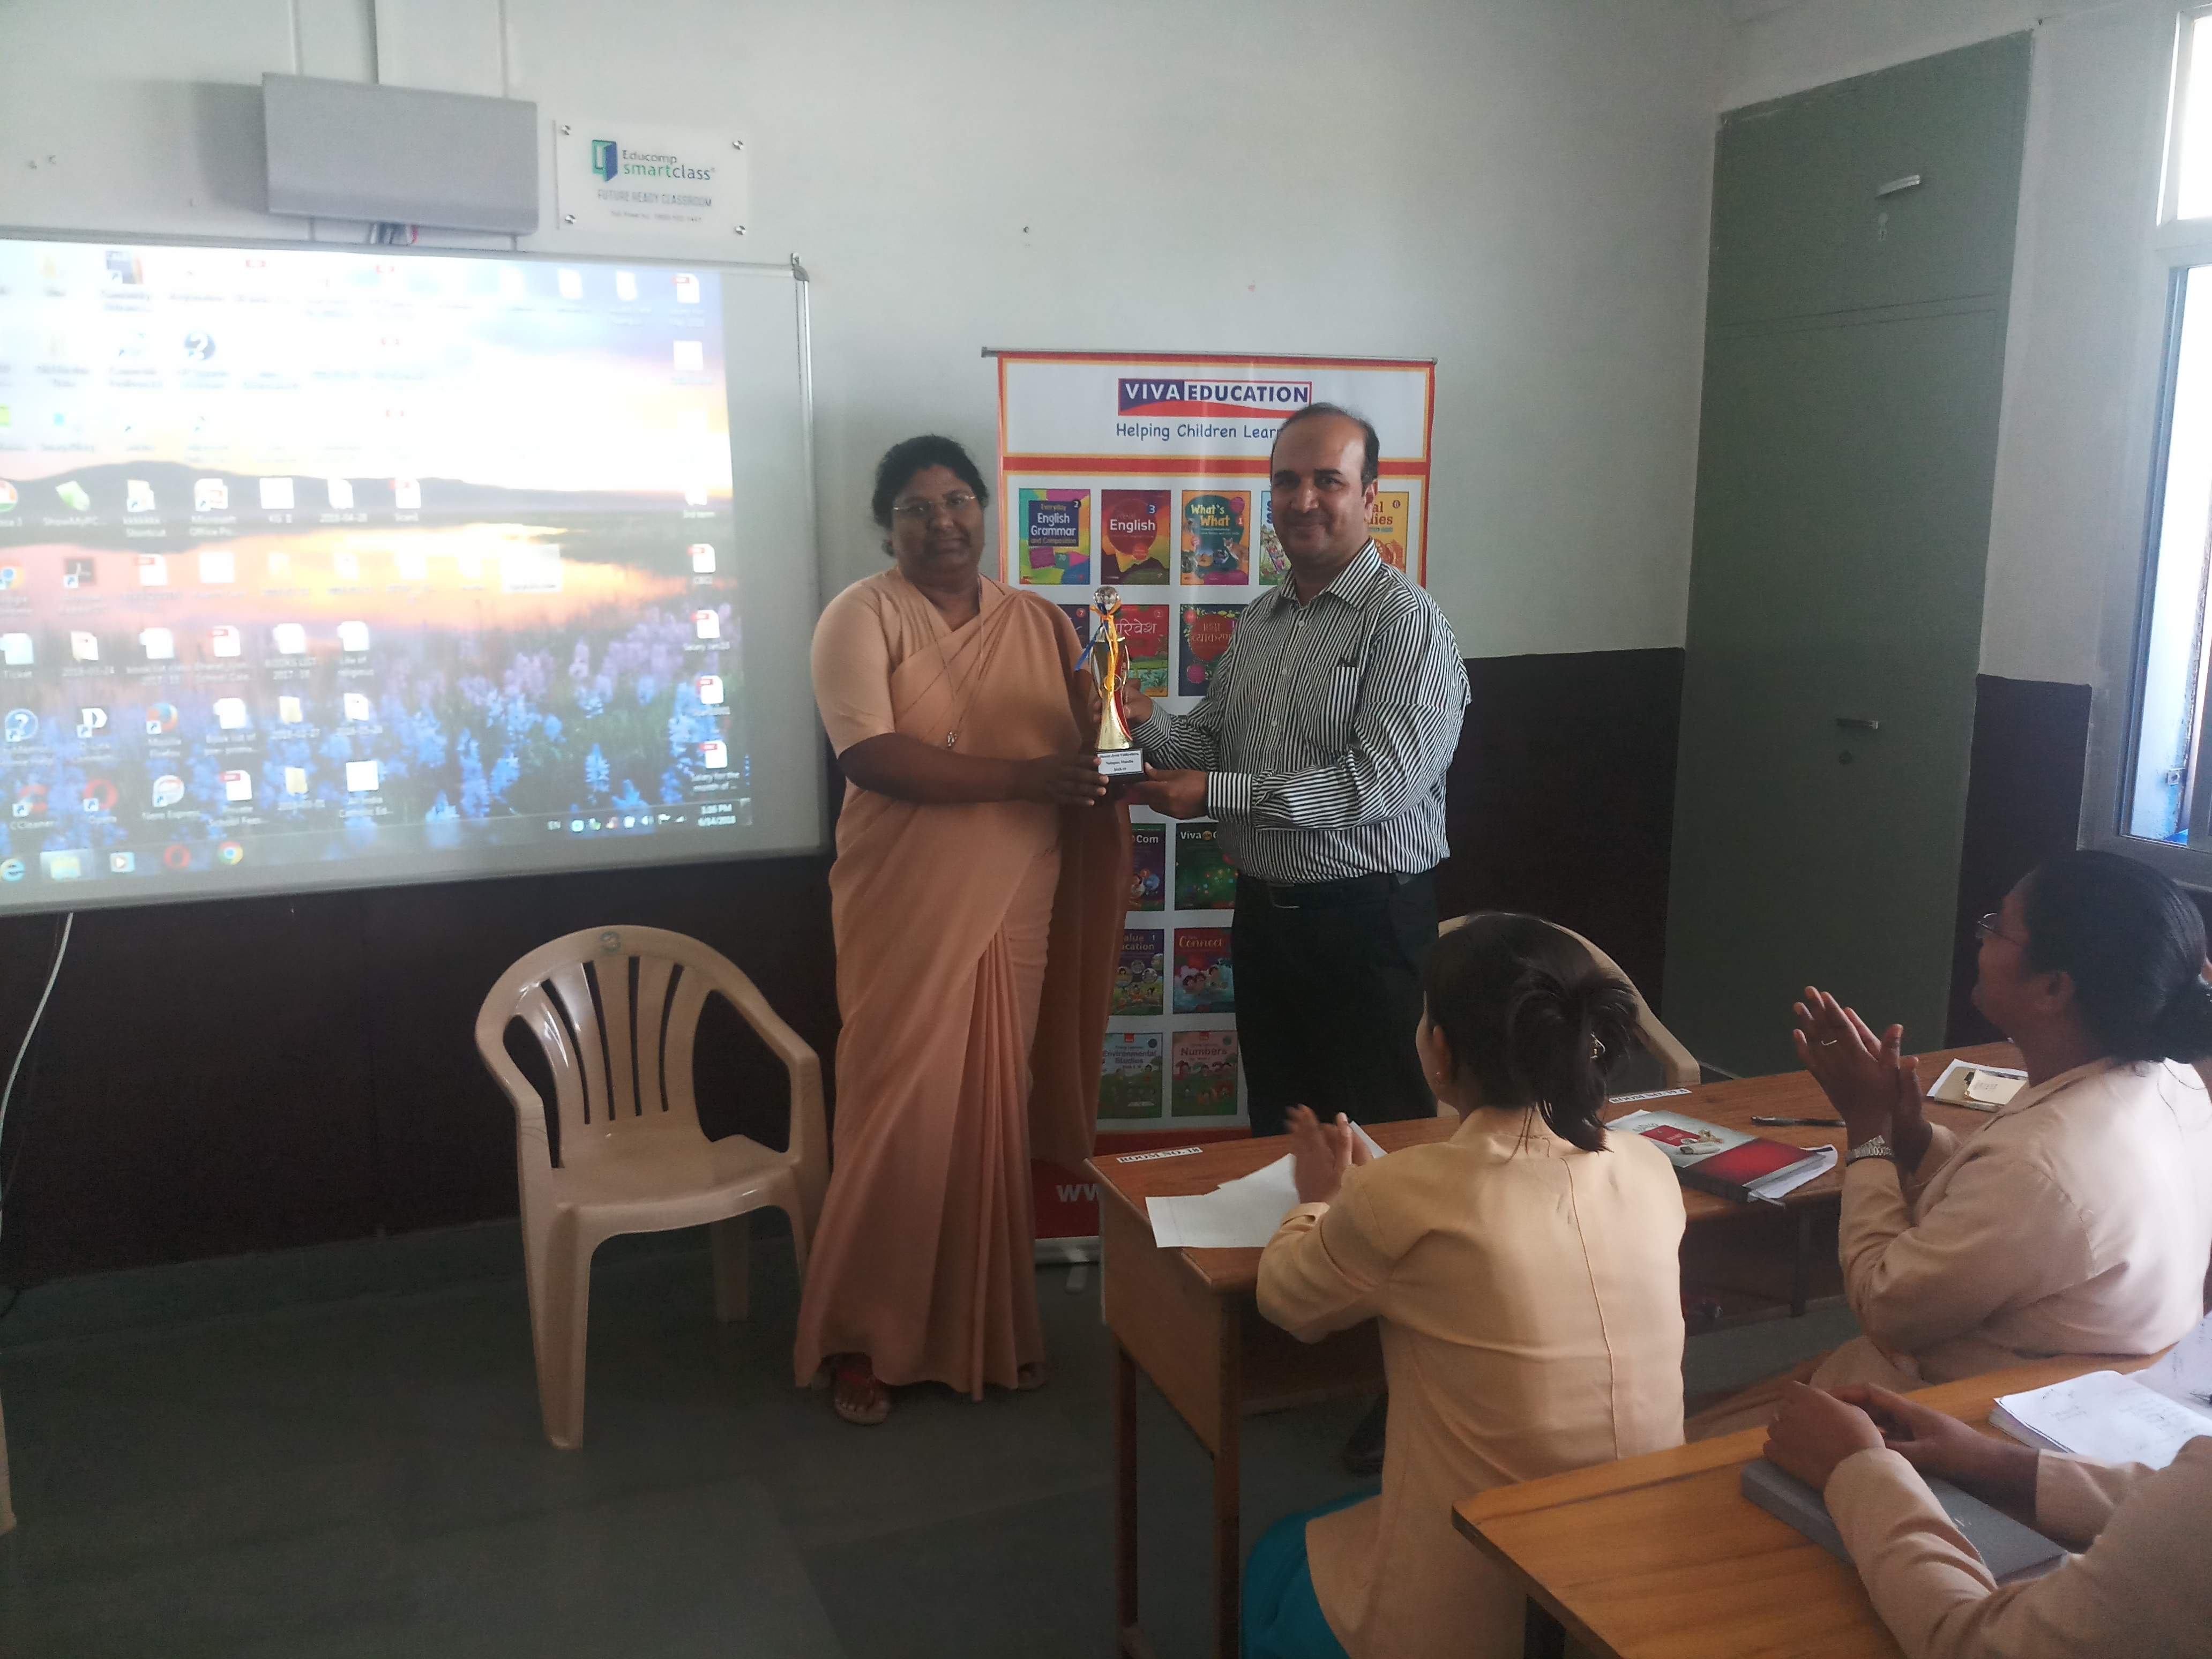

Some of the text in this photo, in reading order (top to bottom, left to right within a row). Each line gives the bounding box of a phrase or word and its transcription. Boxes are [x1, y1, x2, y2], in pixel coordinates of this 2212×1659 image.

[622, 150, 678, 165] Educomp
[1125, 384, 1309, 403] VIVA EDUCATION
[1116, 423, 1170, 441] Helping
[1177, 424, 1237, 438] Children
[1149, 505, 1156, 514] 3
[1191, 504, 1225, 515] What's
[1037, 513, 1070, 527] English
[1200, 515, 1230, 526] What
[1030, 525, 1077, 537] Grammar
[1110, 519, 1156, 533] English
[1137, 835, 1159, 843] Com
[1180, 831, 1201, 840] Viva
[1180, 1048, 1227, 1056] Numbers
[1120, 1153, 1160, 1162] ROOM
